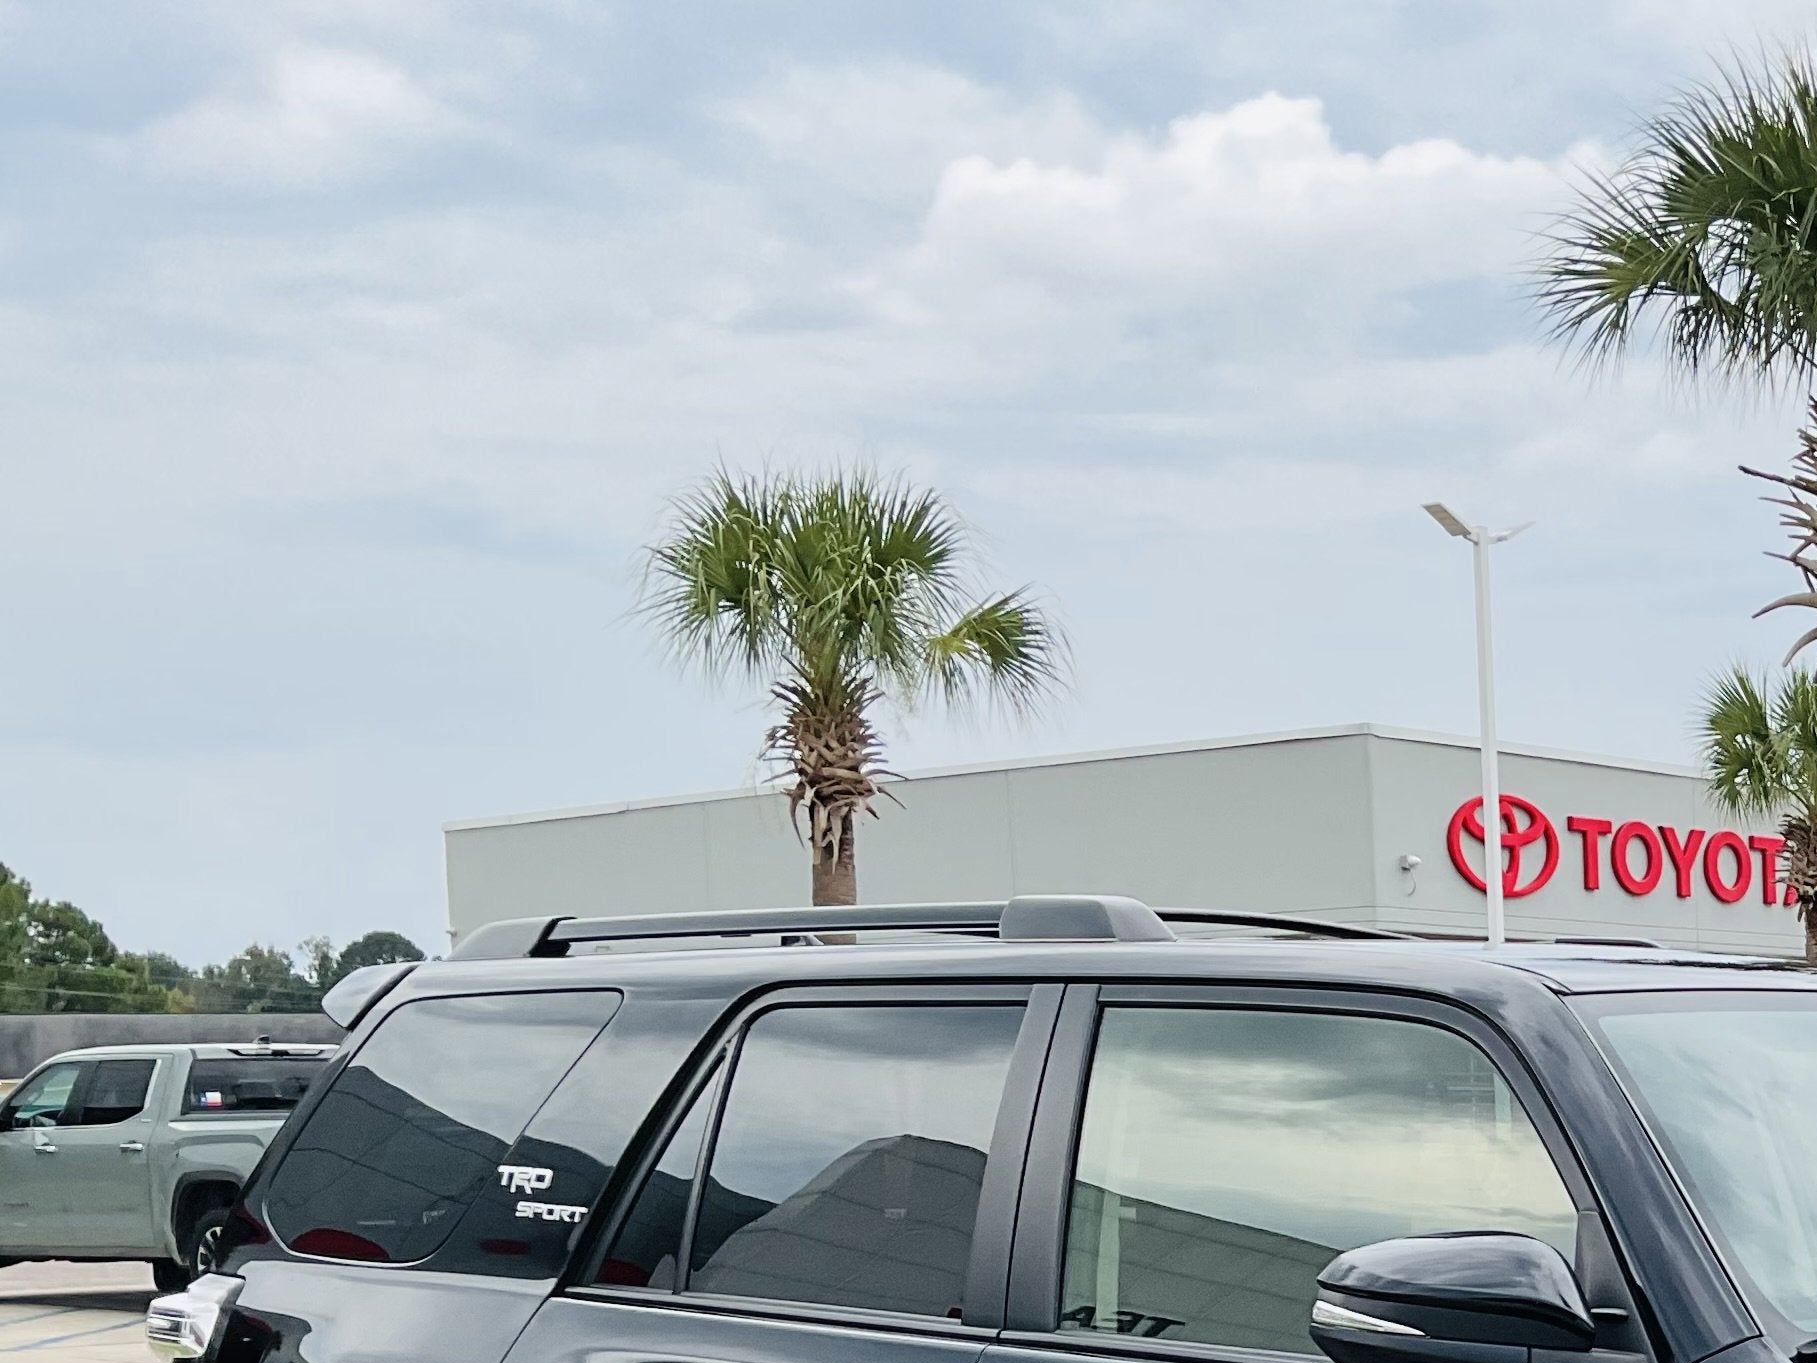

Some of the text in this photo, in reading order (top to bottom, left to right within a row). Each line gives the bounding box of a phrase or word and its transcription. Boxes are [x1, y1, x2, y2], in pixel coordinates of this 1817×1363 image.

[1568, 816, 1799, 907] TOYOT
[497, 1165, 554, 1195] TRD
[515, 1200, 589, 1223] SPORT
